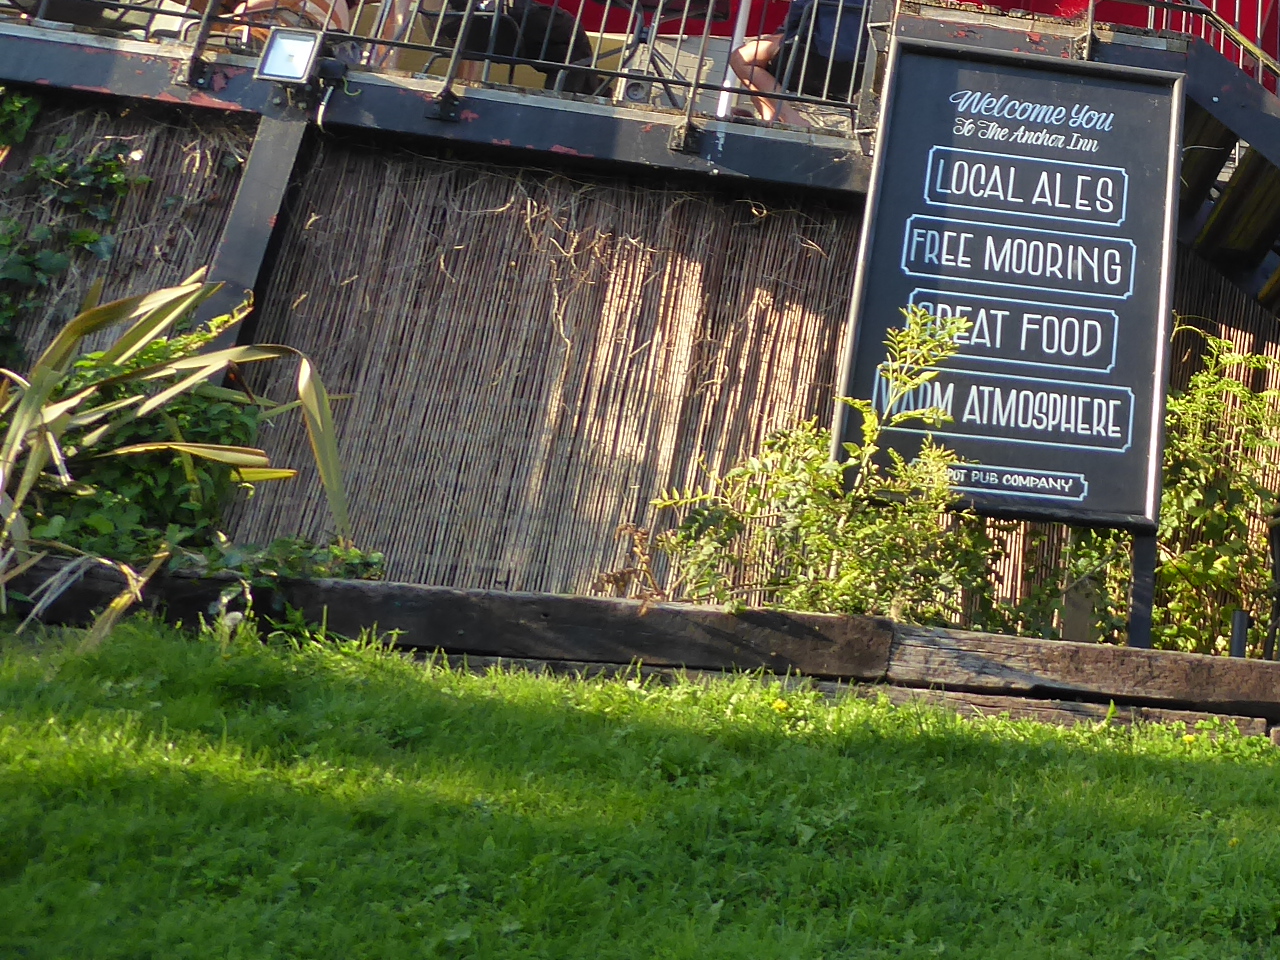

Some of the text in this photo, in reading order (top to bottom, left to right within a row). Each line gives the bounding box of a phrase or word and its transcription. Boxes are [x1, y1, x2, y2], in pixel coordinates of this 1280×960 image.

[949, 90, 1115, 132] Welcome You
[952, 117, 1100, 153] To The Anchor Inn
[936, 158, 1114, 213] LOCAL ALES
[909, 228, 1123, 285] FREE MOORING
[1019, 312, 1103, 357] FOOD
[962, 384, 1123, 438] ATMOSPHERE
[971, 470, 999, 485] PUB
[1002, 474, 1073, 493] COMPANY
